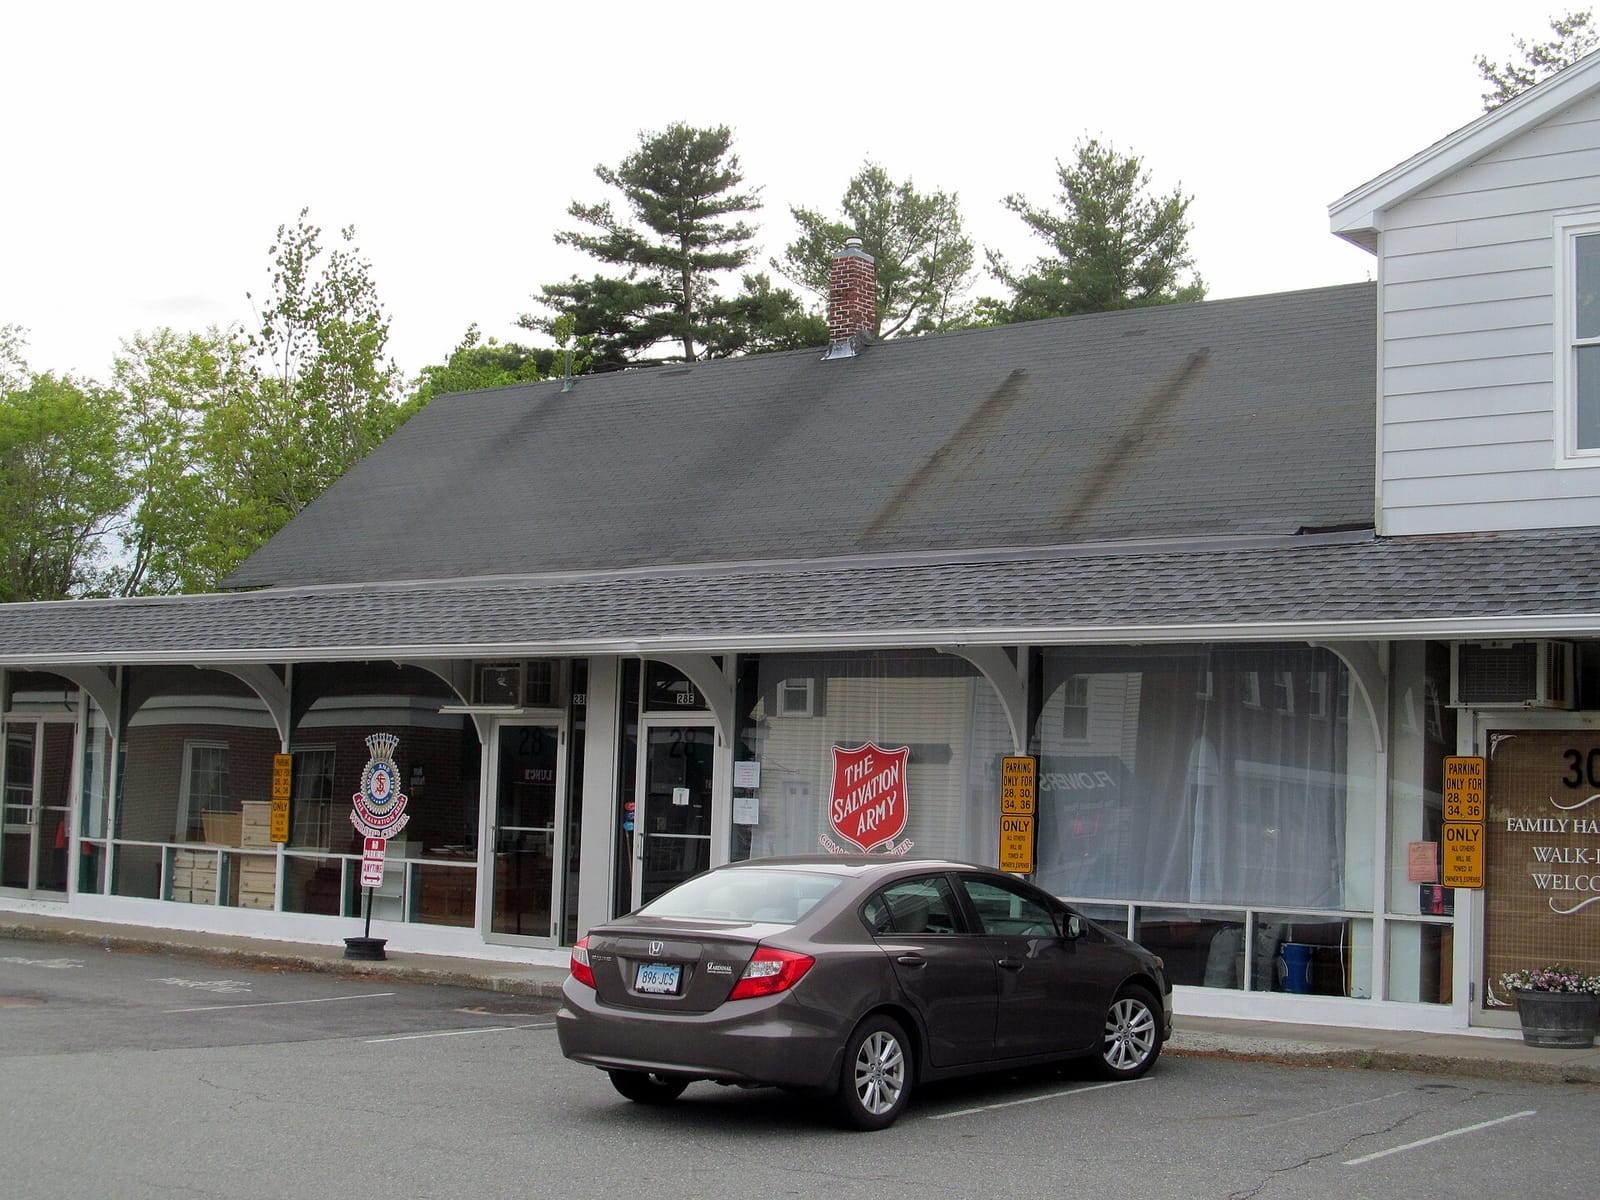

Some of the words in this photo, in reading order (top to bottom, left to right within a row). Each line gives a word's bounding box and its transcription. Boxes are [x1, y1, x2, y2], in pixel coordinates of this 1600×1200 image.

[677, 693, 694, 704] 28E
[669, 729, 696, 758] 28
[844, 753, 874, 788] THE
[1006, 762, 1032, 774] PARKING
[1449, 763, 1480, 775] PARKING
[1562, 749, 1600, 789] 30
[1004, 776, 1018, 786] ONLY
[1021, 776, 1032, 787] FOR
[1446, 778, 1464, 790] ONLY
[1468, 778, 1482, 790] FOR
[833, 760, 899, 823] SALVATION
[1447, 792, 1461, 804] 28,
[272, 802, 287, 812] ONLY
[355, 798, 364, 814] THE
[364, 813, 395, 826] SALVATION
[394, 796, 406, 816] ARMY
[1020, 800, 1031, 809] 36
[1467, 805, 1480, 816] 36
[857, 790, 902, 837] ARMY
[381, 813, 409, 838] CENTER
[1003, 820, 1030, 832] ONLY
[1506, 817, 1568, 833] FAMILY
[1446, 828, 1480, 841] ONLY
[1531, 873, 1600, 891] WELCO
[641, 970, 657, 985] 896
[658, 972, 674, 986] JCS
